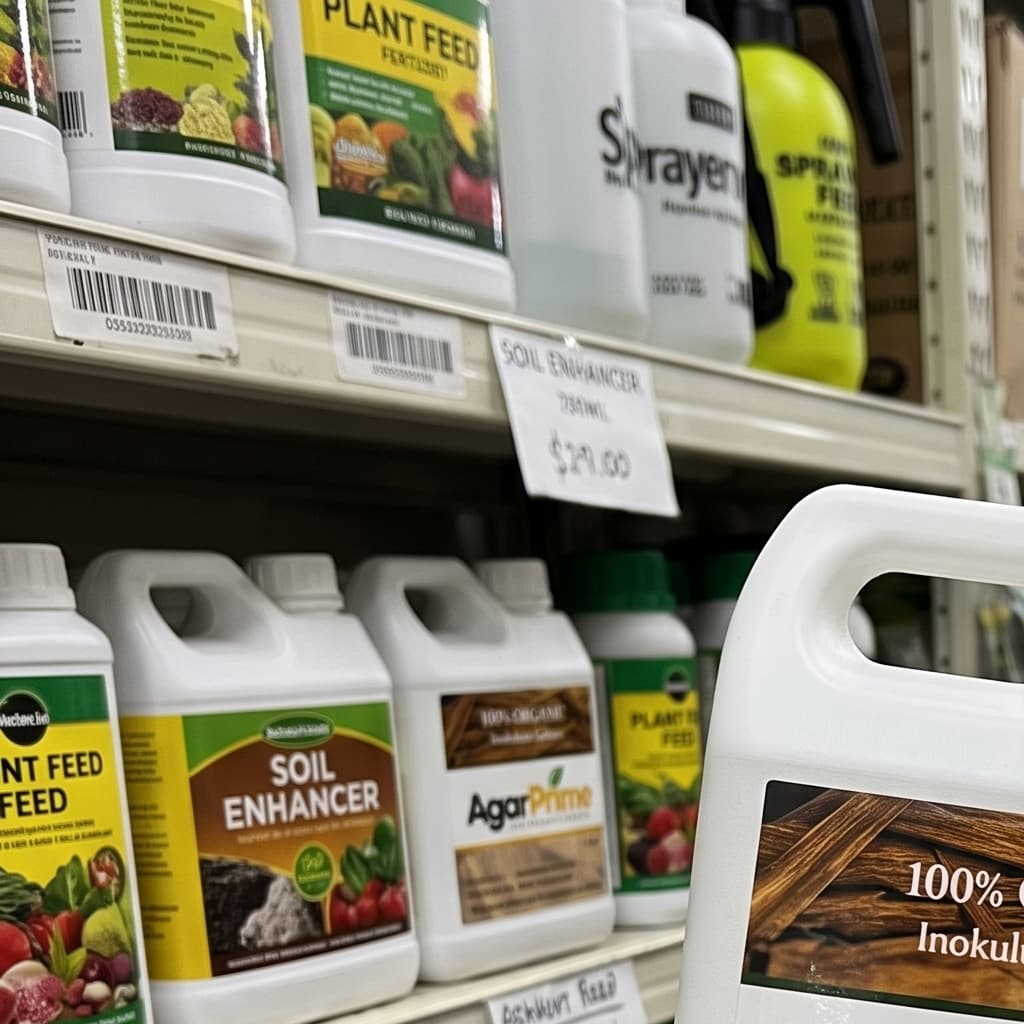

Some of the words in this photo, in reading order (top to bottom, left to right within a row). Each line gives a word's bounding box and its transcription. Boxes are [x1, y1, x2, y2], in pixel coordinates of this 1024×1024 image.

[323, 0, 416, 47] PLANT
[423, 21, 480, 71] FEED
[502, 338, 545, 374] SOIL
[47, 751, 103, 780] FEED
[270, 750, 336, 788] SOIL
[0, 786, 68, 819] FEED
[223, 779, 380, 831] ENHANCER
[468, 783, 592, 833] AgarPrime
[905, 860, 1003, 909] 100%
